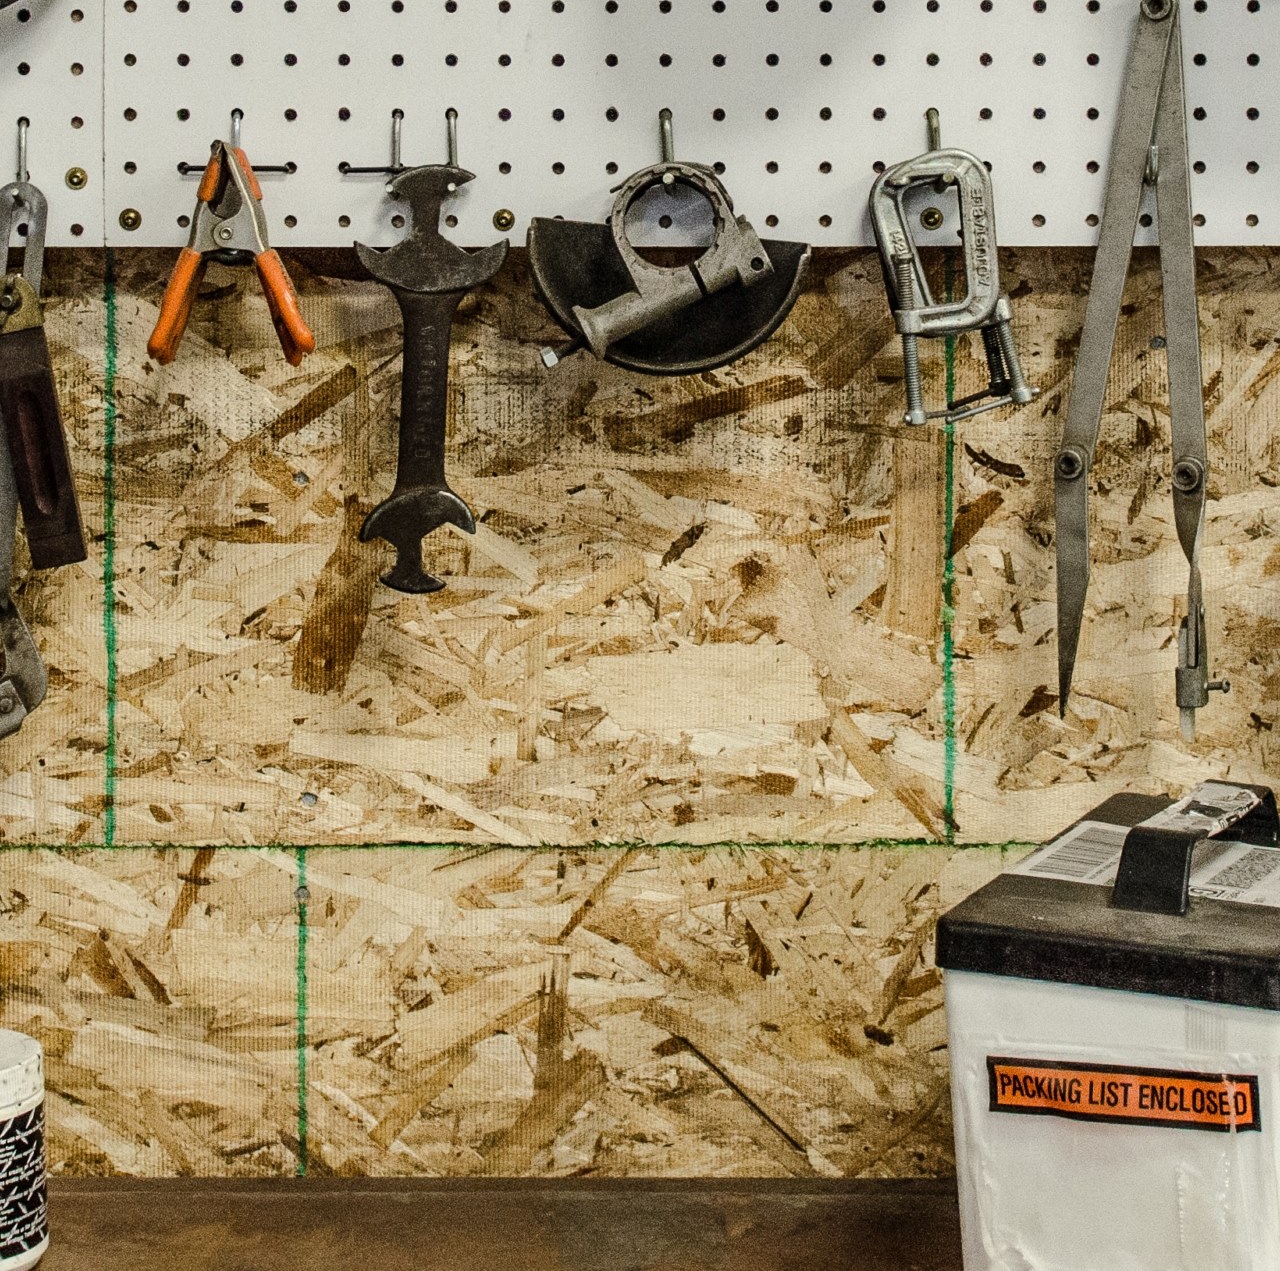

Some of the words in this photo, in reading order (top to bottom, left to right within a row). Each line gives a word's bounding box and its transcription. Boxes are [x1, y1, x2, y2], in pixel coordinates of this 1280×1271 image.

[999, 1072, 1082, 1105] PACKING
[1087, 1079, 1133, 1108] LIST
[1138, 1083, 1248, 1117] ENCLOSED
